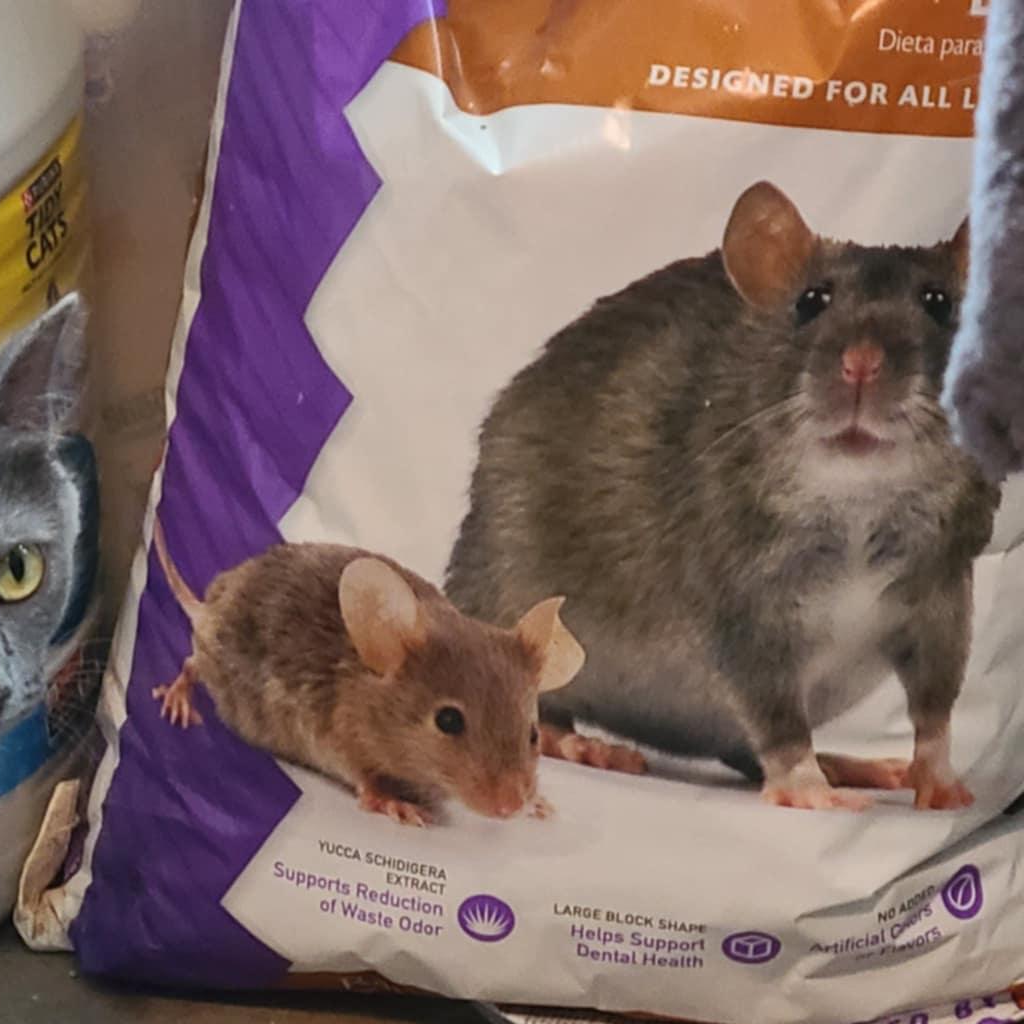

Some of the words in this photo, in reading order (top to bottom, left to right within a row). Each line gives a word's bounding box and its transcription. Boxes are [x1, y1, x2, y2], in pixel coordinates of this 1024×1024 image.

[878, 28, 936, 54] Dieta
[940, 37, 983, 60] para
[648, 64, 814, 99] DESIGNED
[825, 80, 888, 105] FOR
[898, 84, 952, 109] ALL
[26, 210, 68, 270] CATS
[318, 839, 362, 862] YUCCA
[365, 851, 447, 881] SCHIDIGERA
[273, 860, 352, 896] Supports
[356, 882, 445, 918] Reduction
[386, 872, 446, 896] EXTRACT
[319, 898, 337, 915] of
[341, 901, 394, 929] Waste
[399, 916, 444, 938] Odor
[553, 903, 602, 921] LARGE
[605, 910, 654, 929] BLOCK
[658, 918, 707, 935] SHAPE
[877, 907, 896, 923] NO
[570, 924, 625, 944] Helps
[630, 931, 706, 953] Support
[809, 929, 885, 954] Artificial
[576, 942, 637, 967] Dental
[642, 951, 704, 969] Health
